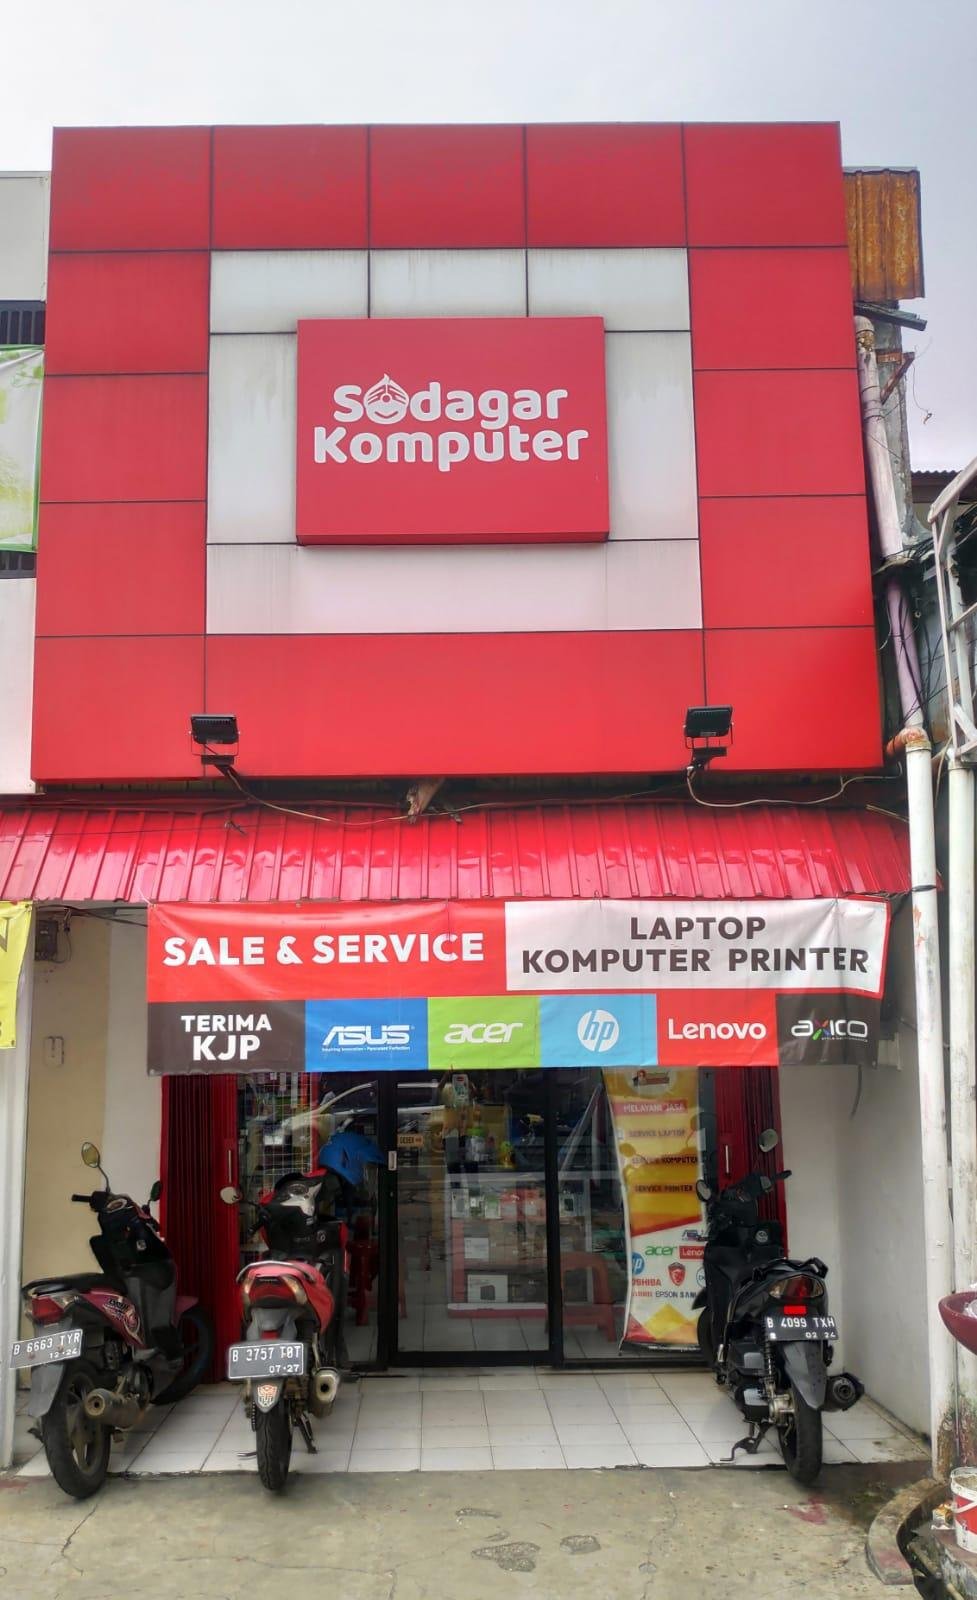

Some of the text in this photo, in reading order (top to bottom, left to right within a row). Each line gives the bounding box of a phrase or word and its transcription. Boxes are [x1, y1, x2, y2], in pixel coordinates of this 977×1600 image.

[333, 374, 568, 430] Sodagar
[314, 426, 589, 472] Komputer
[630, 916, 766, 940] LAPTOP
[163, 933, 484, 966] SALE & SERVICE
[522, 948, 868, 973] KOMPUTER PRINTER
[181, 1014, 272, 1032] TERIMA
[444, 1023, 523, 1043] acer
[582, 1011, 616, 1050] hp
[668, 1018, 767, 1040] Lenovo
[322, 1025, 410, 1046] ASUS
[193, 1035, 260, 1061] KJP
[645, 1246, 677, 1256] acer
[766, 1317, 835, 1328] B 4099 TXH
[13, 1332, 81, 1356] B 6663 TYR
[232, 1349, 239, 1362] B
